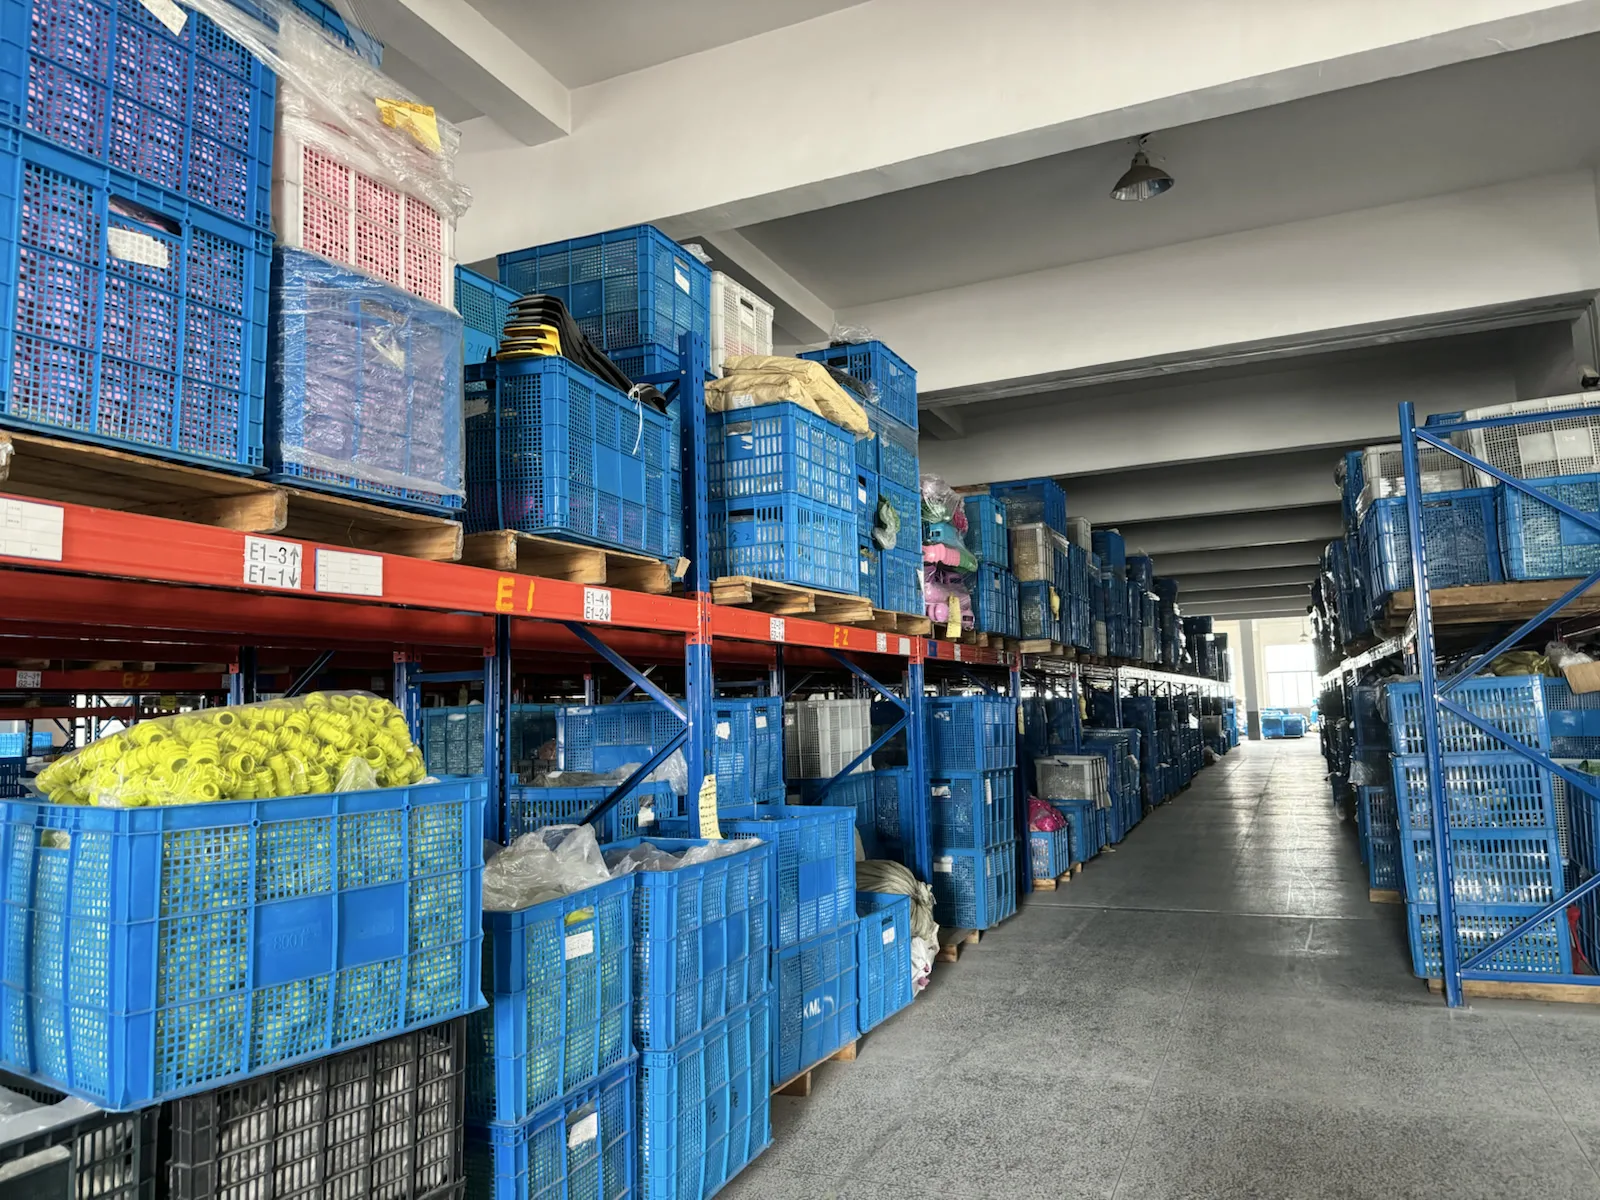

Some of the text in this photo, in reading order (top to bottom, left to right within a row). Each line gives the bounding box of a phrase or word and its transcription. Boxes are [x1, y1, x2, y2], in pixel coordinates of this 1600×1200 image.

[250, 541, 288, 565] E1-3
[248, 564, 285, 587] E1-1
[586, 591, 605, 605] E1-4
[586, 606, 605, 620] E1-2
